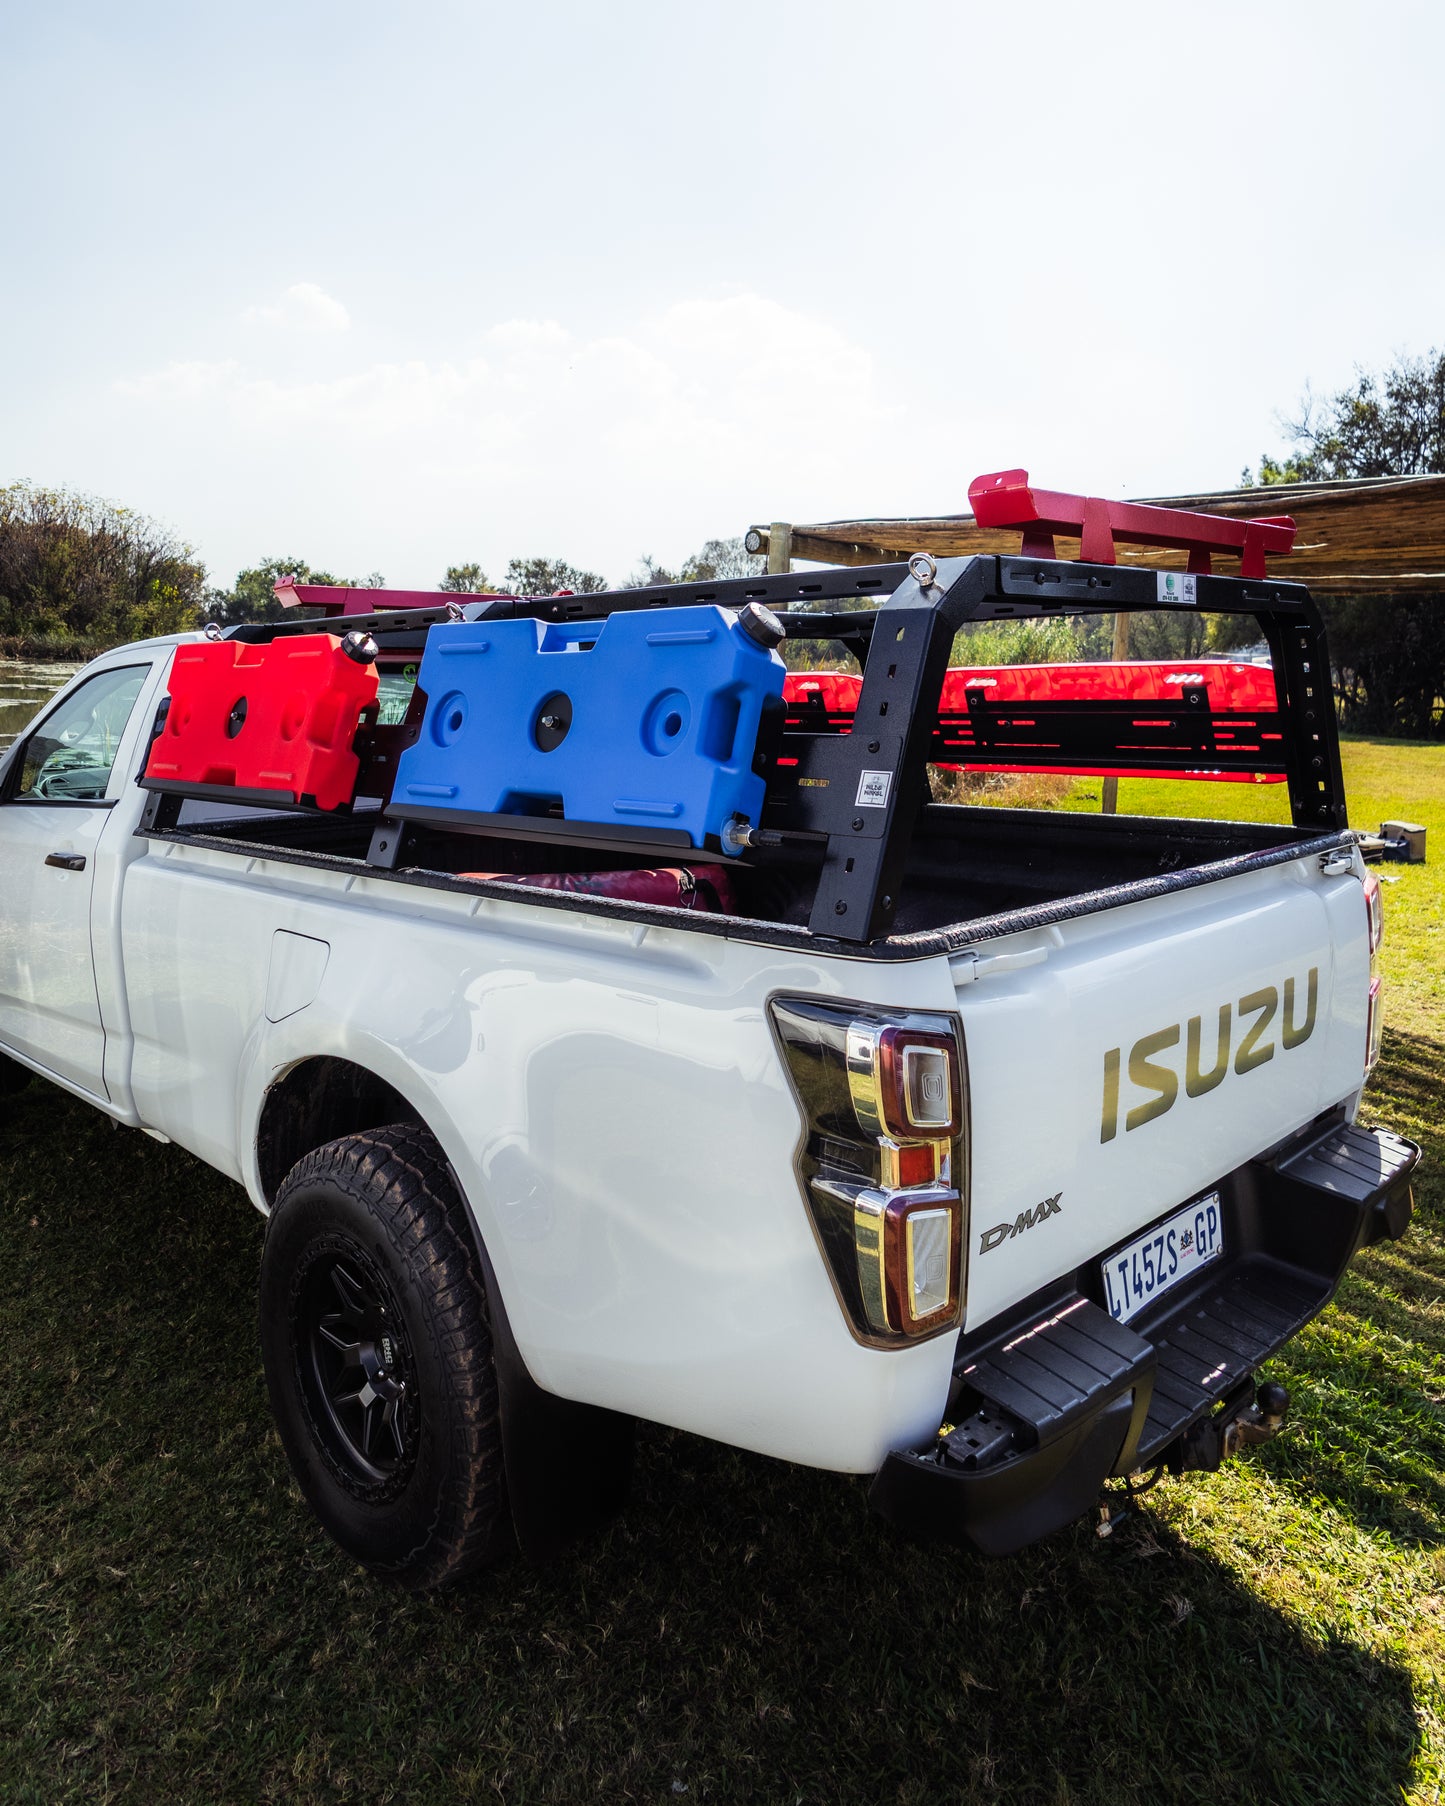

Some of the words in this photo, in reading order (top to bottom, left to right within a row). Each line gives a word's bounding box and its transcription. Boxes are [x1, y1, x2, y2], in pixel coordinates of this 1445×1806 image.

[1100, 967, 1318, 1145] ISUZU
[979, 1192, 1063, 1255] D-MAX
[1105, 1229, 1178, 1319] LT45ZS
[1194, 1205, 1218, 1256] GP
